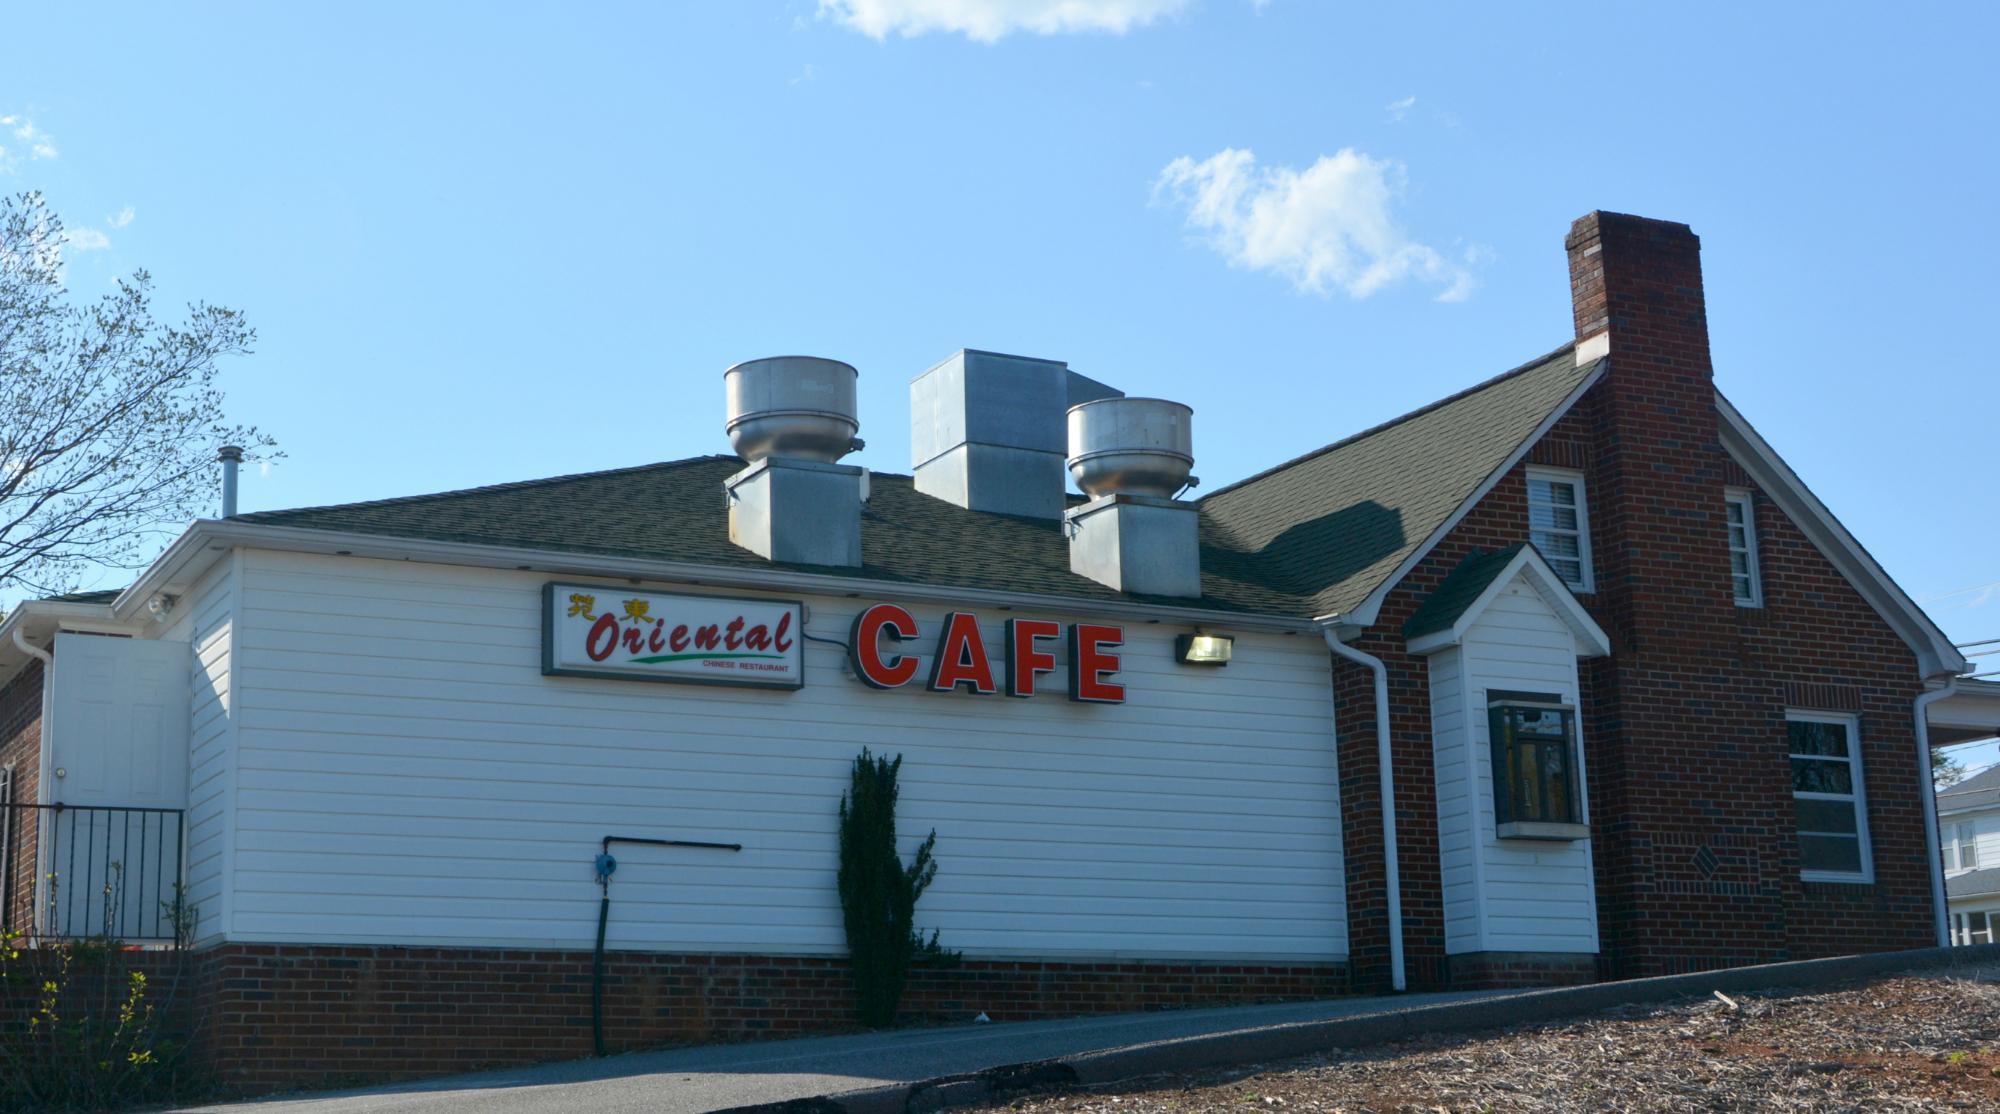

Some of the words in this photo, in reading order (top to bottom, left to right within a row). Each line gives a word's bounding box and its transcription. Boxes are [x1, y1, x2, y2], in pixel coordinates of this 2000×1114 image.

[586, 612, 793, 662] Oriental
[850, 603, 1126, 704] CAFE
[703, 660, 736, 669] CHINESE
[739, 662, 789, 672] RESTAURANT
